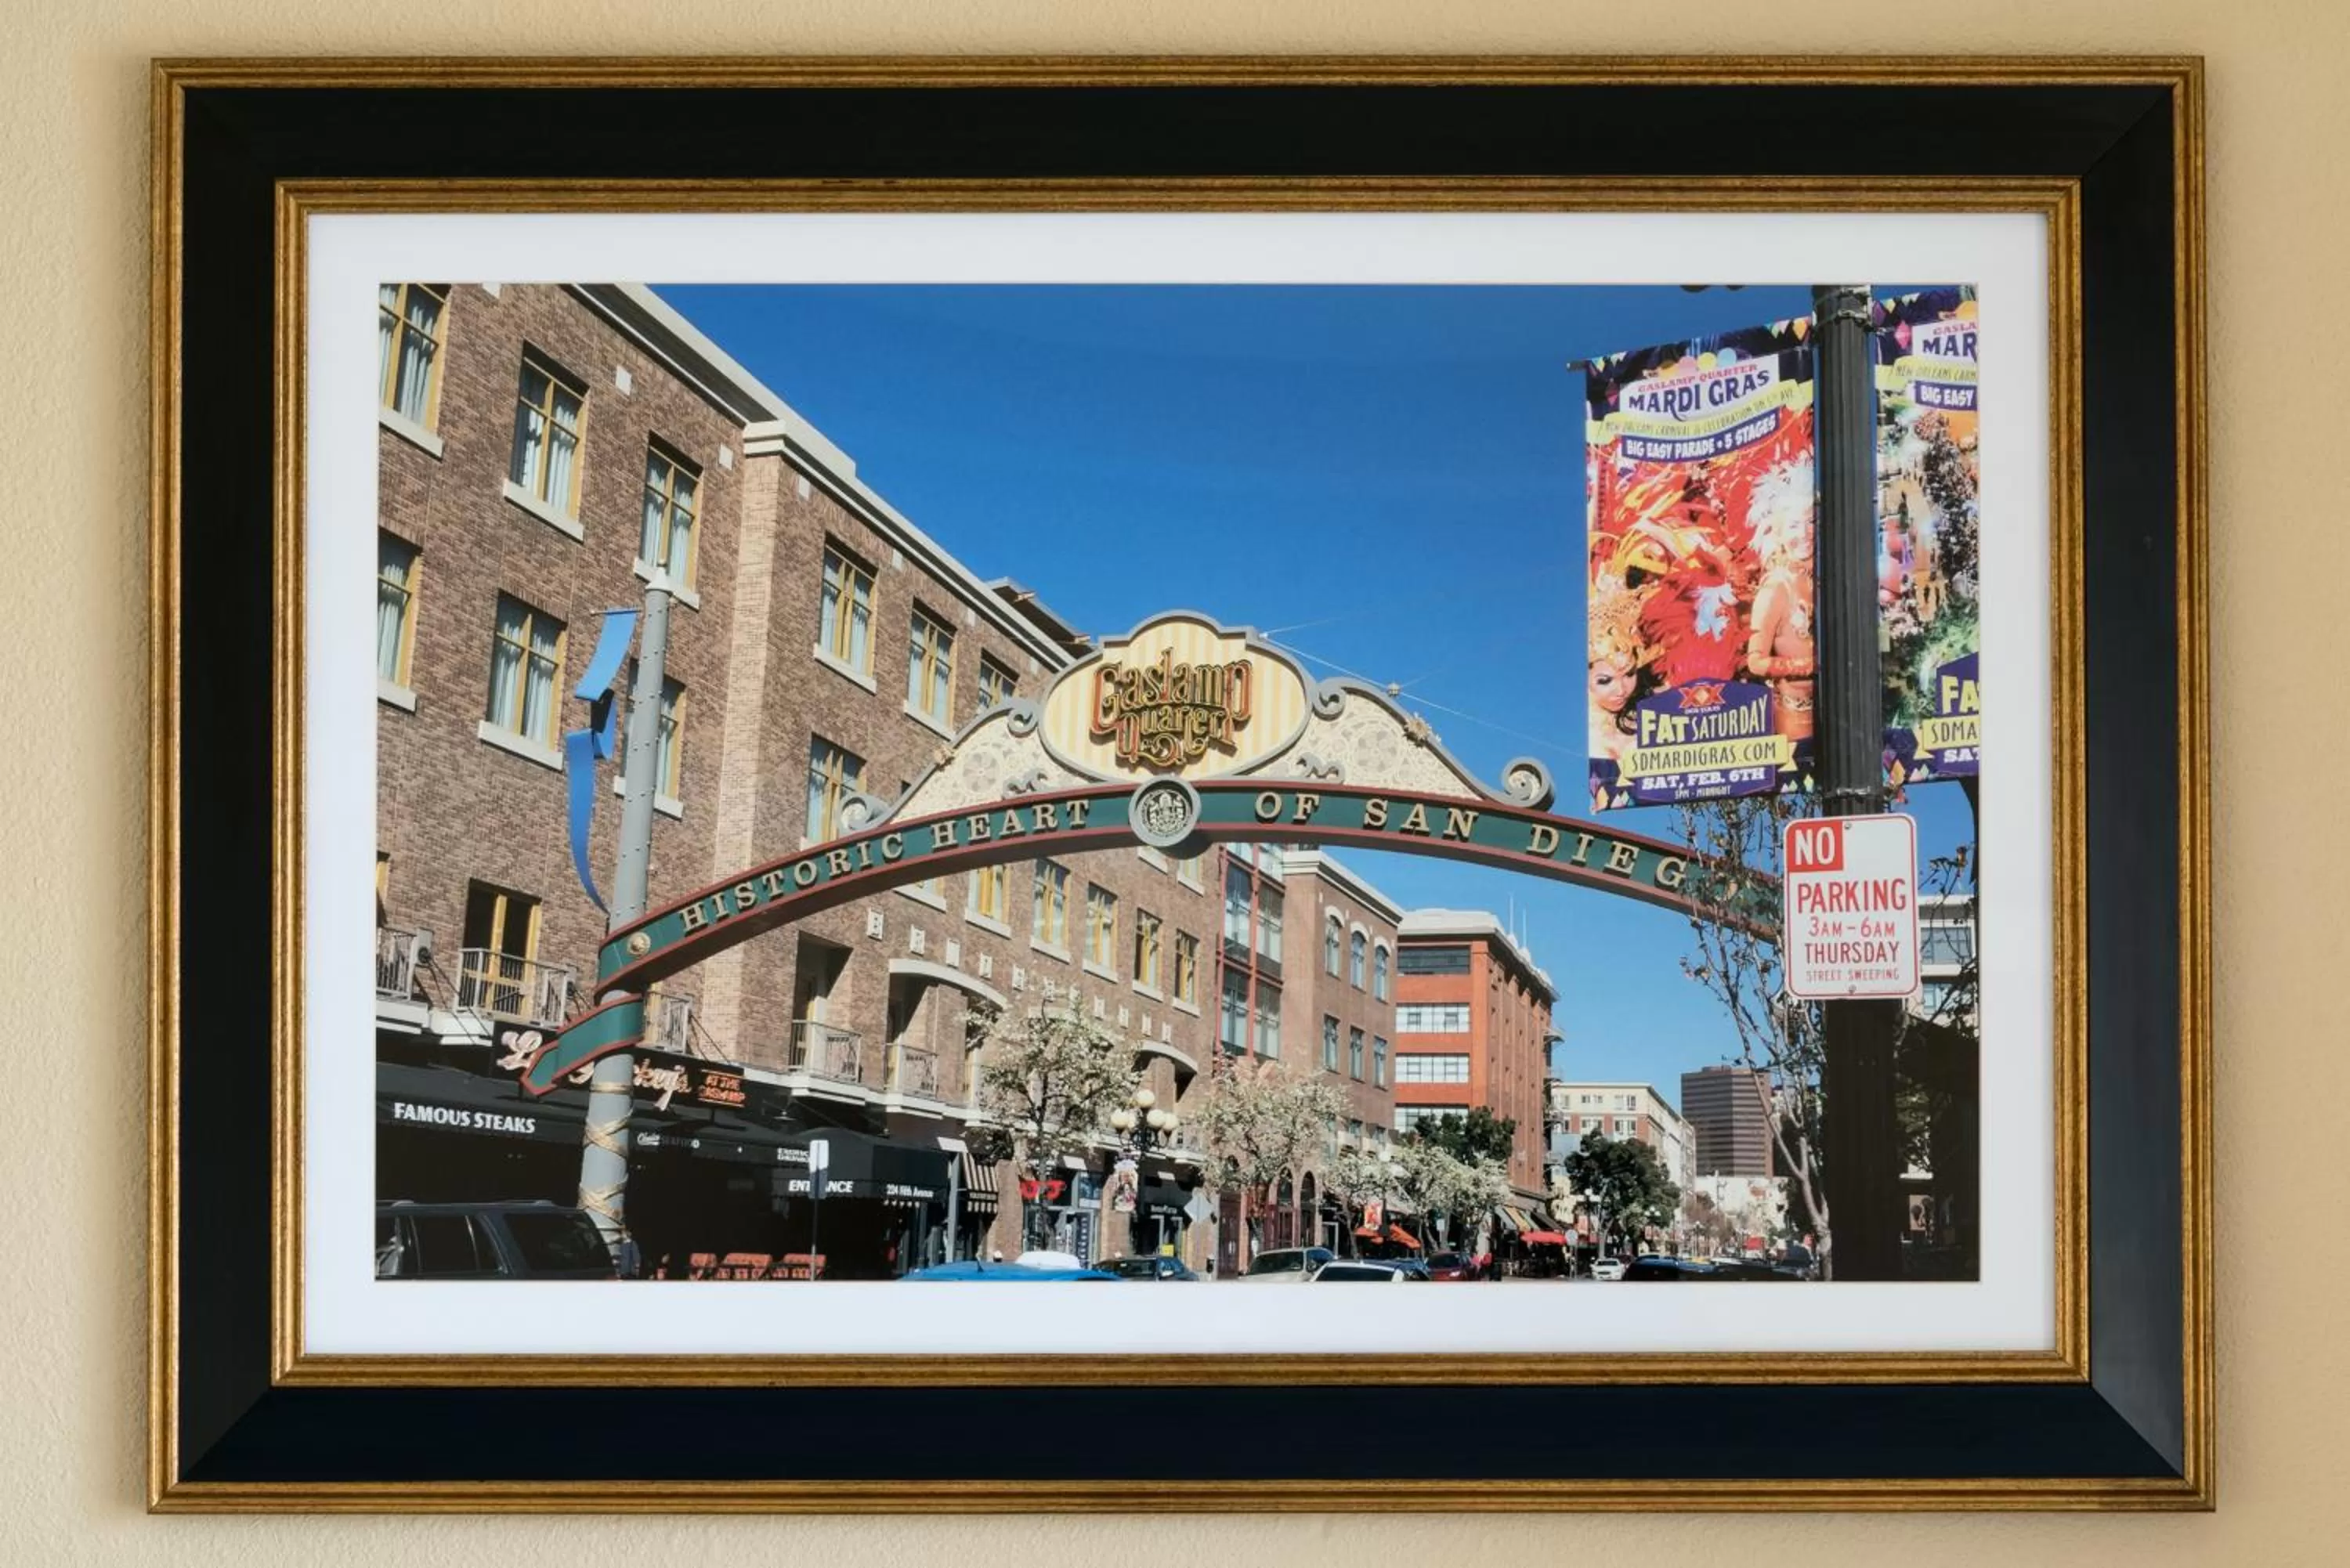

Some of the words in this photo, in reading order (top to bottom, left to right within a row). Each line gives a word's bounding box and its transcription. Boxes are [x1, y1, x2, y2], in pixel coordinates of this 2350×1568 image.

[1922, 331, 1978, 364] MAR
[1638, 375, 1696, 392] GASLAMP
[1700, 363, 1757, 382] QUARTER
[1629, 384, 1701, 421] MARDI
[1708, 370, 1770, 406] GRAS
[1920, 385, 1941, 403] BIG
[1943, 388, 1975, 406] EASY
[1625, 439, 1644, 456] BIG
[1647, 442, 1672, 459] EASY
[1675, 437, 1716, 459] PARADE
[1724, 432, 1734, 450] 5
[1735, 412, 1777, 446] STAGES
[1090, 647, 1253, 736] Gaslamp
[1941, 674, 1979, 714] FA
[1641, 709, 1690, 746] FAT
[1691, 694, 1768, 742] SATURDAY
[1687, 770, 1726, 787] FEB.
[1729, 766, 1766, 782] 6TH
[677, 833, 906, 933] HISTORIC
[931, 799, 1090, 849] HEART
[1255, 791, 1320, 820] OF
[1363, 797, 1480, 838] SAN
[1526, 822, 1737, 899] DIEG
[1794, 826, 1835, 865] NO
[1797, 877, 1906, 914] PARKING
[1860, 916, 1896, 938] 6AM
[1804, 941, 1900, 965] THURSDAY
[1806, 970, 1842, 982] STREET
[1848, 967, 1900, 981] SWEEPING
[394, 1102, 471, 1127] FAMOUS
[474, 1111, 537, 1134] STEAKS
[788, 1180, 854, 1194] ENTNCE
